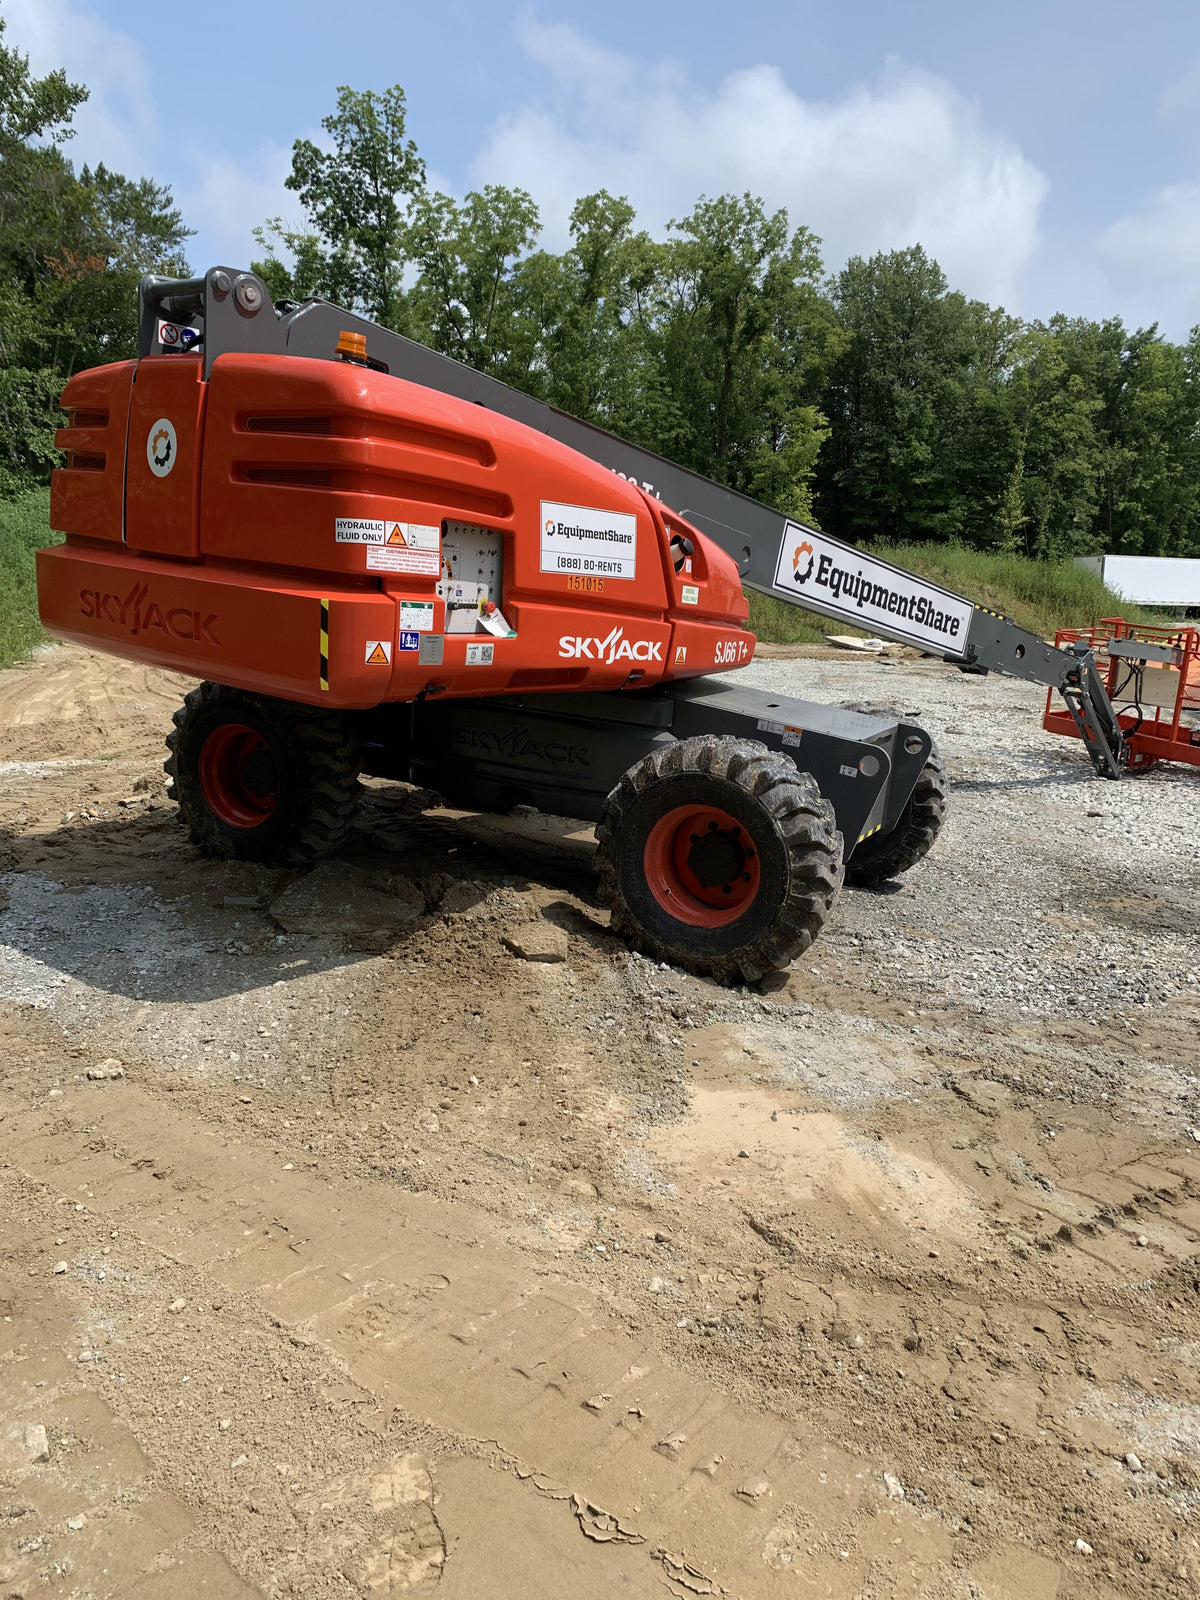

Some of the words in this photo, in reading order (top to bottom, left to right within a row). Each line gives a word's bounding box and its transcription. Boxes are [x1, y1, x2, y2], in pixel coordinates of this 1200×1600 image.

[337, 521, 383, 531] HYDRAULIC
[337, 531, 360, 540] FLUID
[362, 533, 383, 542] ONLY
[557, 522, 632, 544] EquipmentShare
[557, 556, 581, 570] (888)
[583, 559, 622, 573] 80-RENTS
[568, 576, 604, 592] 151015
[814, 553, 960, 637] EquipmentShare
[80, 581, 222, 647] SKYJACK
[558, 625, 663, 665] SKYJACK
[714, 641, 736, 664] SJ66
[737, 641, 748, 662] T+
[454, 726, 592, 767] SKYJACK
